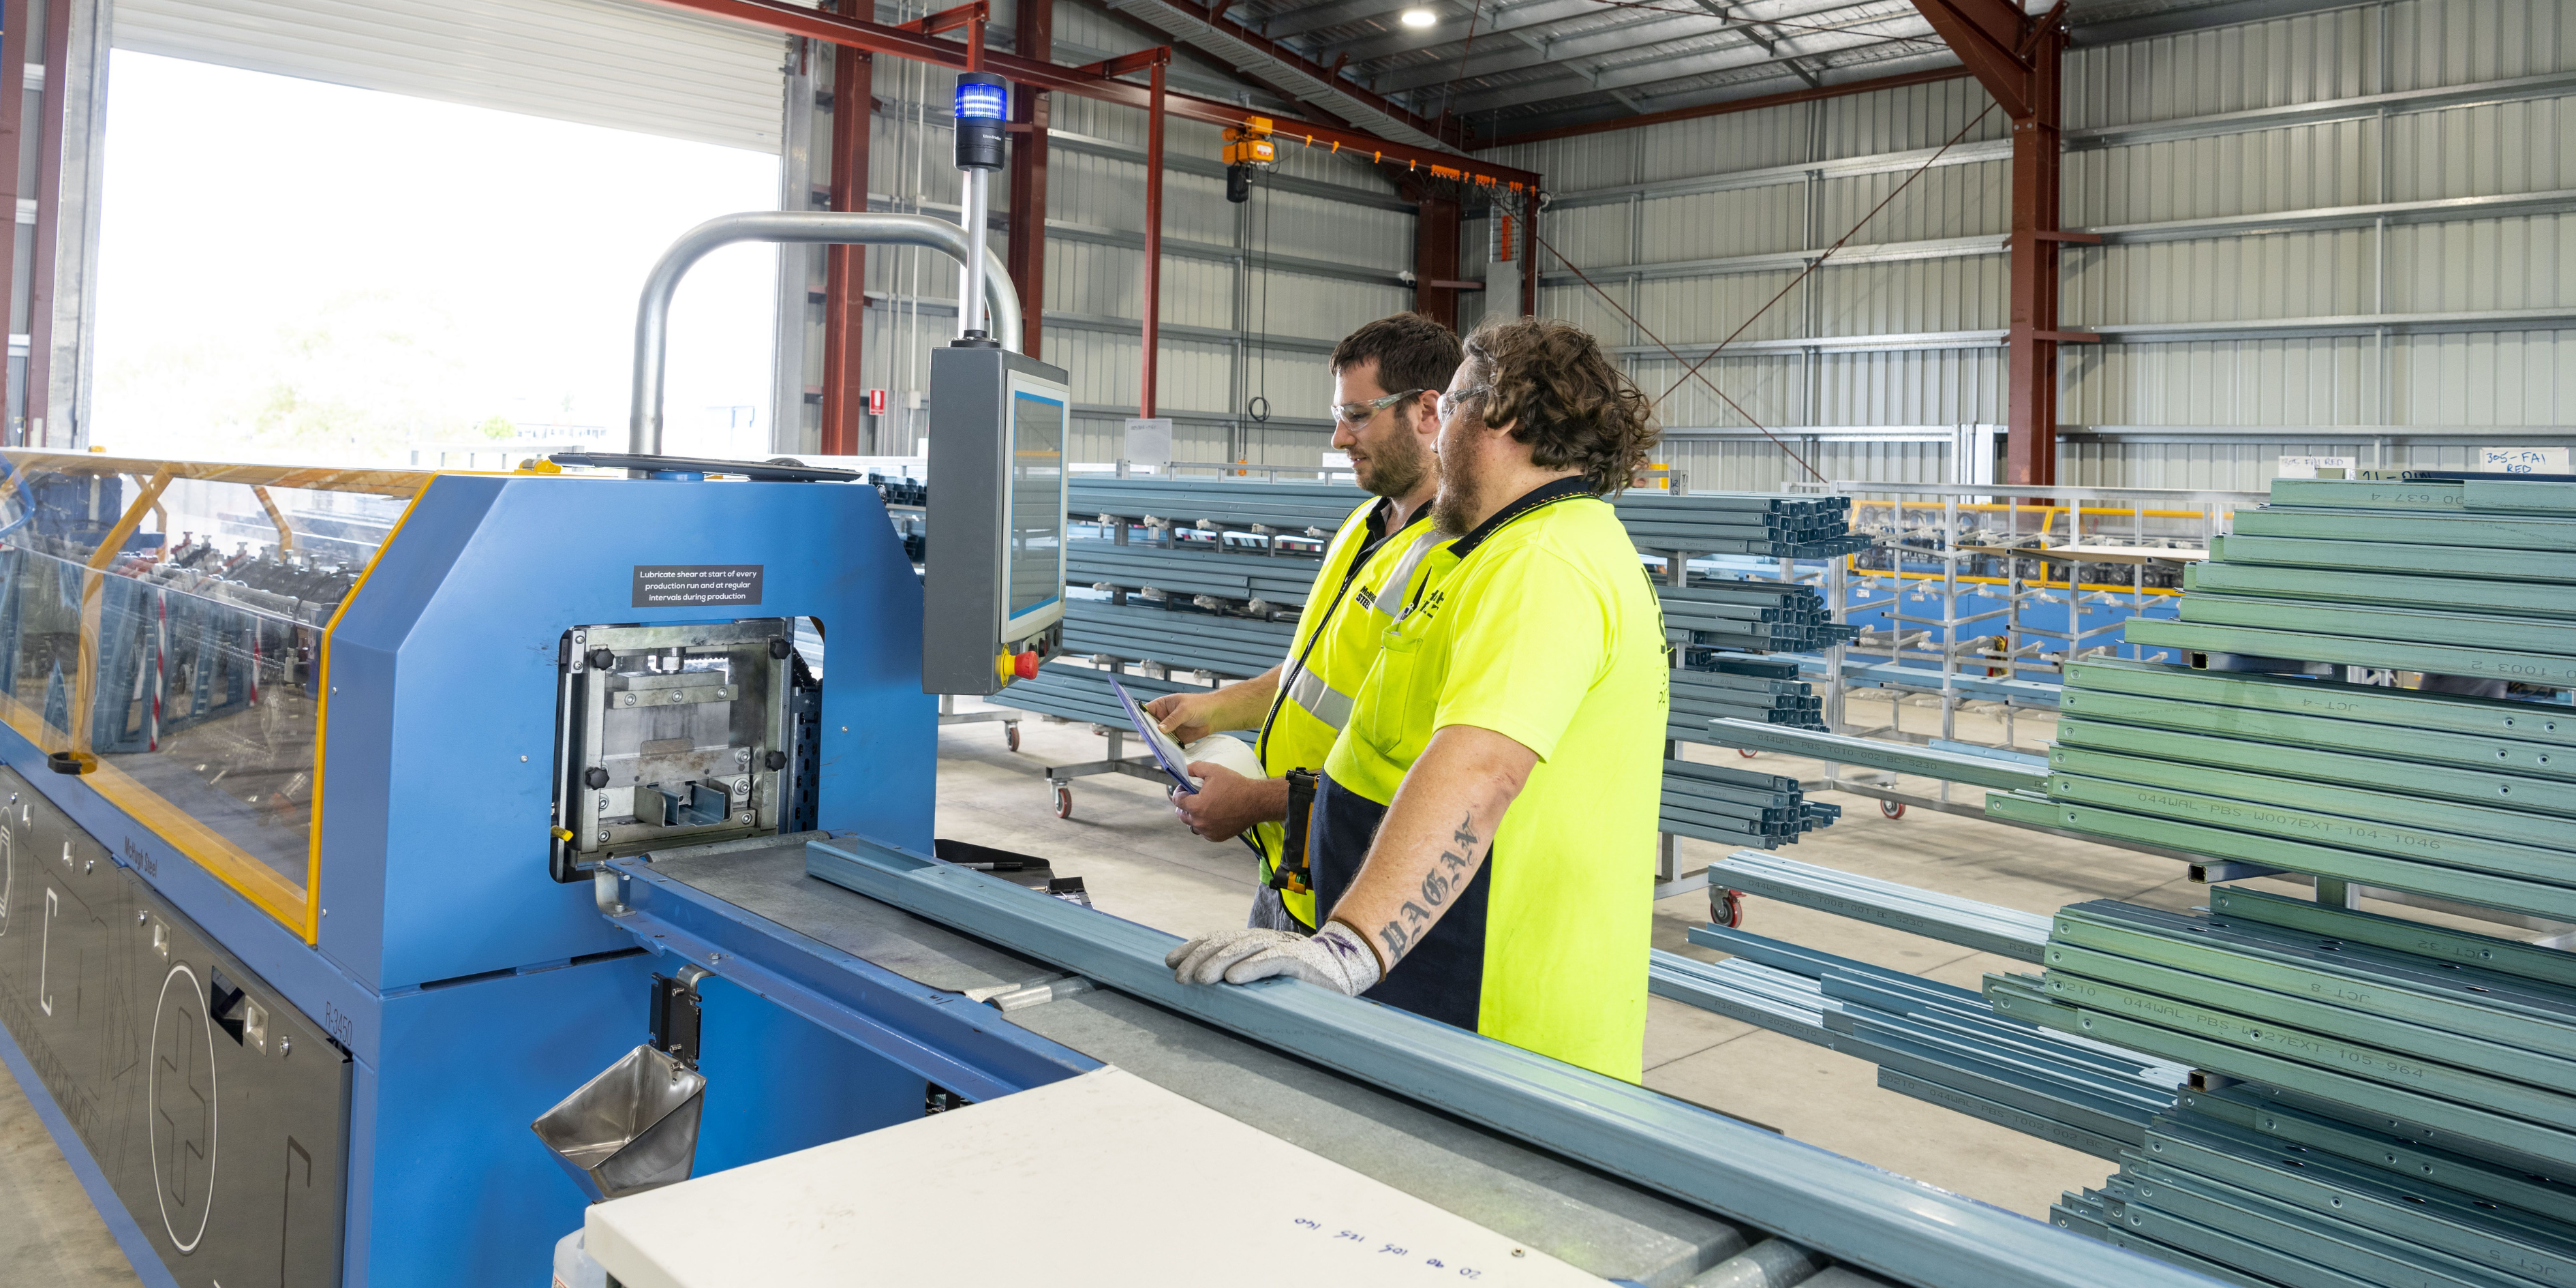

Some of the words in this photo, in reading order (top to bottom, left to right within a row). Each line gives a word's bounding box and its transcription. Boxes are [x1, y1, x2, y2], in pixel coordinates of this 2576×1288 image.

[2325, 457, 2344, 466] RED
[2506, 463, 2532, 474] RED
[640, 570, 676, 579] Lubricate
[736, 570, 757, 579] every
[645, 582, 686, 591] production
[724, 581, 751, 590] regular
[682, 593, 706, 602] during
[707, 592, 746, 602] production
[2301, 698, 2359, 712] JCT-4
[2137, 793, 2441, 850] 044WAL-PBS-W007EXT-104-1046
[124, 835, 144, 872] McHugh
[144, 851, 157, 879] Steel
[2310, 983, 2371, 1003] JCT-8
[325, 1000, 352, 1047] R-3450
[2489, 1248, 2558, 1276] JCT-5
